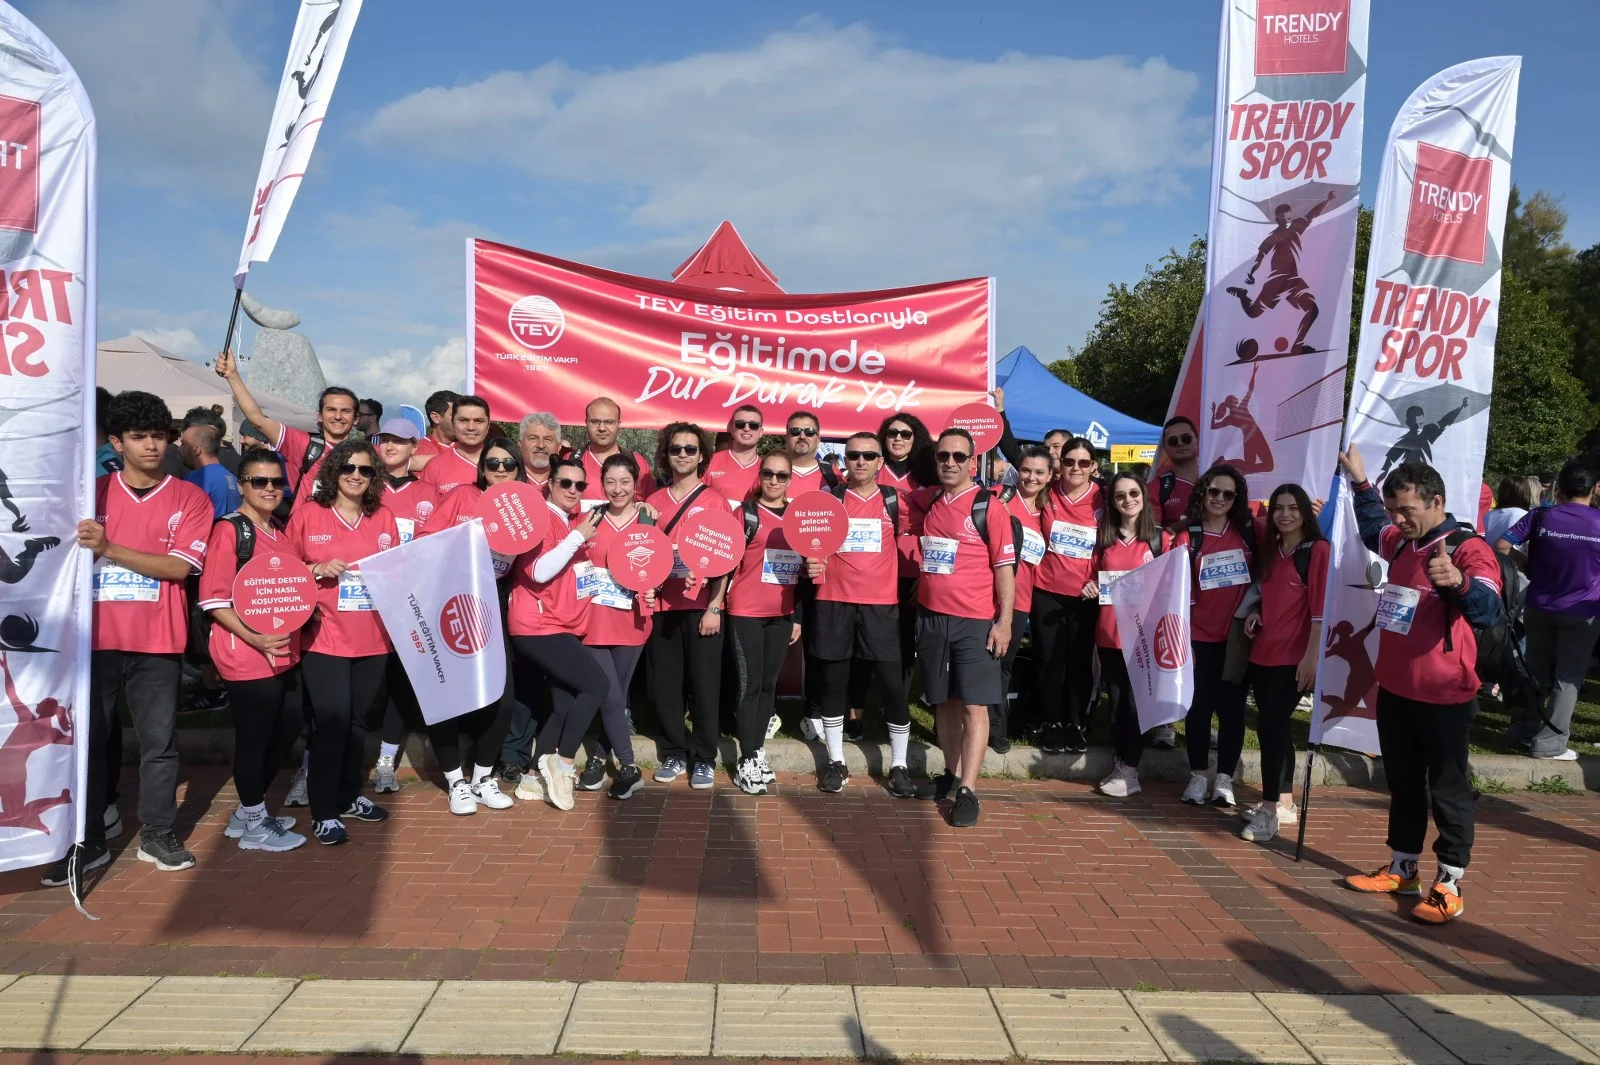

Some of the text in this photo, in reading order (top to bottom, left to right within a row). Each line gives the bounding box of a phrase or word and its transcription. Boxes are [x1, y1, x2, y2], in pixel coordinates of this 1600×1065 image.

[1264, 12, 1342, 34] TRENDY
[1284, 34, 1318, 44] HOTELS
[1228, 100, 1355, 140] TRENDY
[1239, 141, 1332, 180] SPOR
[1418, 180, 1482, 214] TRENDY
[1432, 210, 1463, 224] HOTELS
[635, 294, 928, 329] TEV Eğitim Dostlarıyla
[1370, 279, 1491, 338] TRENDY
[516, 323, 558, 336] TEV
[680, 331, 886, 375] Eğitimde
[1374, 330, 1468, 381] SPOR
[635, 366, 923, 412] Dur Durak Yok
[493, 498, 501, 508] ne
[510, 493, 534, 532] Eğitim için
[500, 492, 528, 540] koşmayan da
[695, 533, 730, 550] eğitim için
[699, 524, 732, 544] Yorgunluk,
[848, 531, 879, 539] 2494
[685, 536, 734, 560] koşunca güzel.
[1024, 540, 1041, 553] 485
[770, 563, 800, 572] 12489
[1203, 563, 1244, 576] 12486
[244, 577, 276, 586] EĞİTİME
[256, 587, 272, 596] İÇİN
[274, 605, 310, 613] BAKALIM!
[1378, 601, 1409, 615] 2484
[447, 602, 469, 650] TEV
[408, 594, 445, 683] TÜRK EĞİTİM VAKFI
[410, 630, 426, 654] 1967
[1158, 621, 1173, 665] TEV
